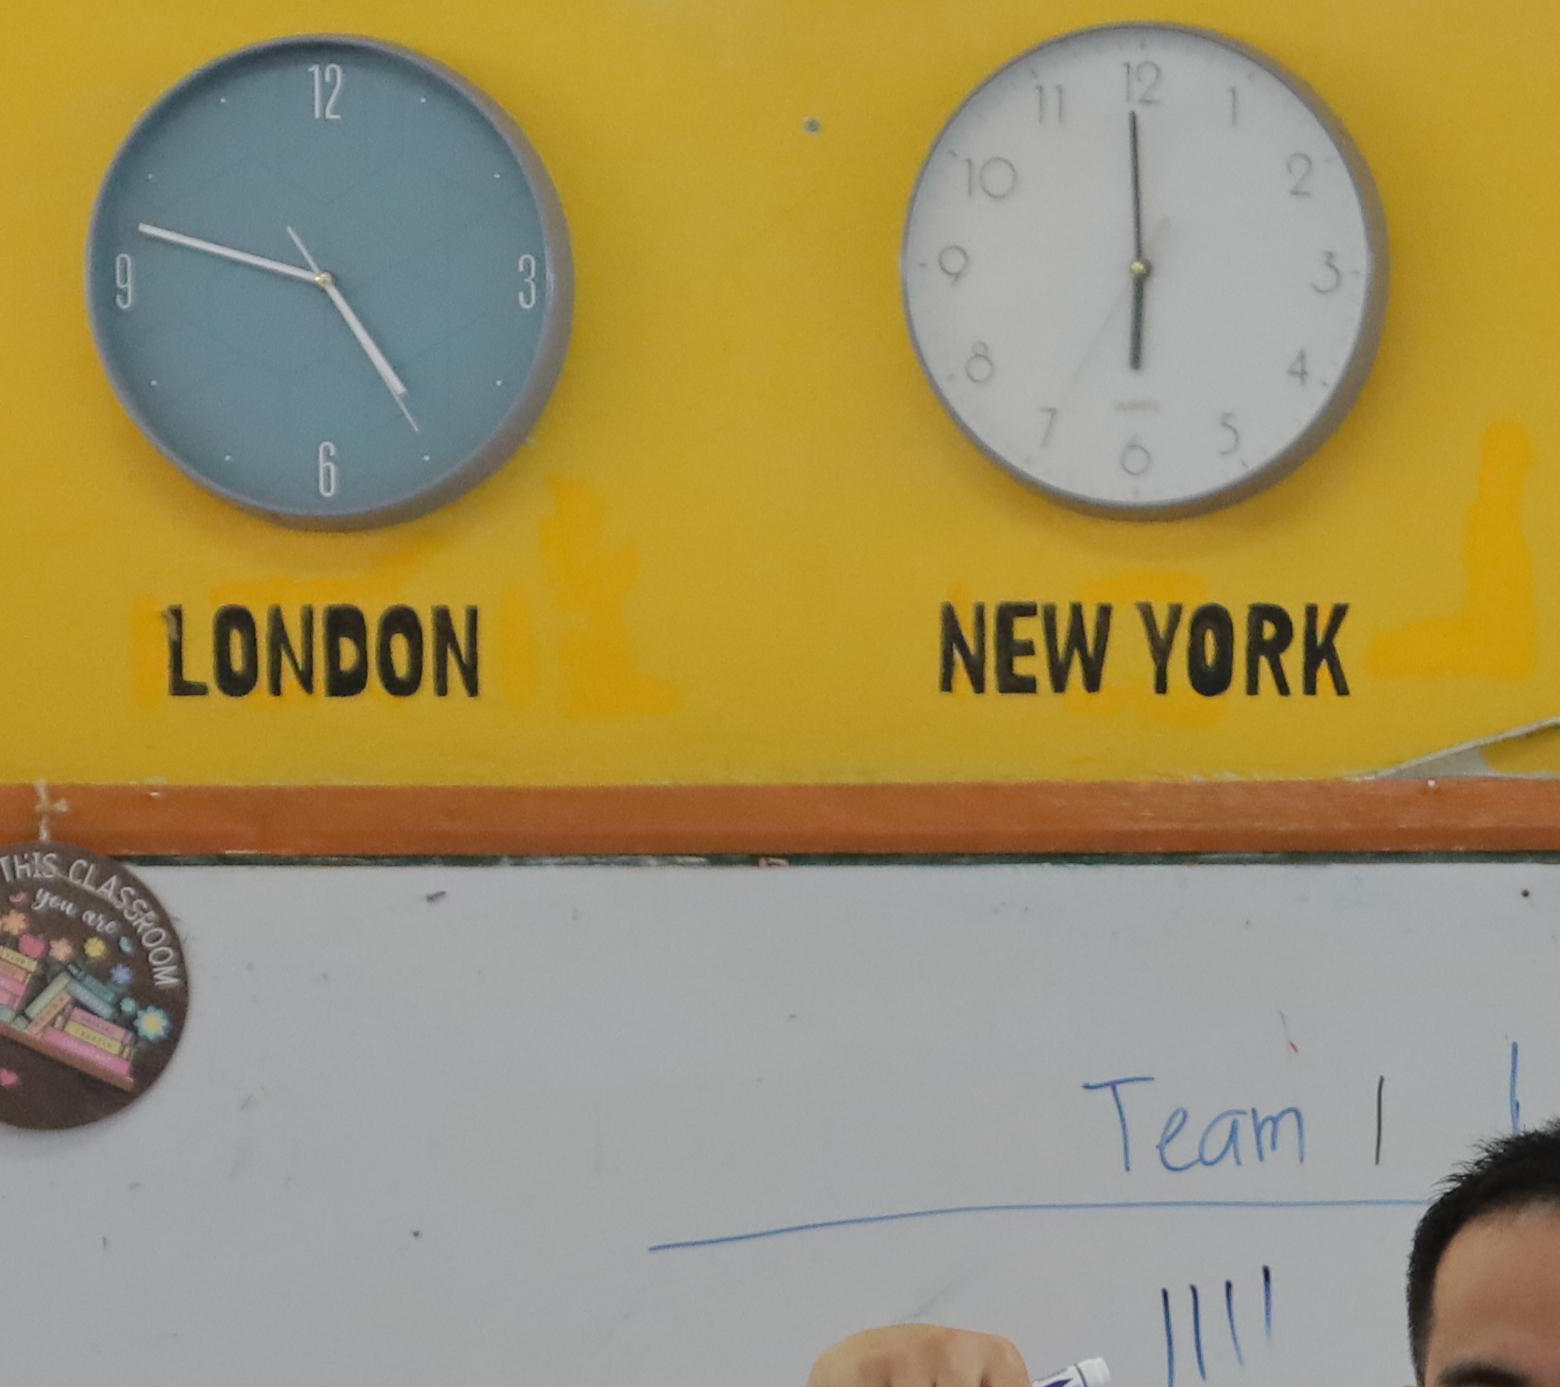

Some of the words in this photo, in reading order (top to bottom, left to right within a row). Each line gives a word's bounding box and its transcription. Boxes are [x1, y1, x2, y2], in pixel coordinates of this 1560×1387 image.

[309, 64, 342, 119] 12
[1036, 84, 1066, 124] 11
[1123, 61, 1161, 105] 12
[1228, 86, 1237, 126] 1
[963, 156, 1017, 200] 10
[1287, 152, 1311, 196] 2
[116, 254, 133, 308] 9
[519, 255, 536, 308] 3
[939, 245, 969, 284] 9
[1311, 251, 1340, 293] 3
[964, 341, 995, 383] 8
[1287, 348, 1309, 385] 4
[1040, 407, 1058, 448] 7
[1220, 412, 1240, 455] 5
[319, 442, 336, 497] 6
[1120, 437, 1151, 475] 6
[168, 605, 480, 697] LONDON
[939, 600, 1110, 694] NEW
[1137, 602, 1351, 698] YORK
[32, 888, 77, 917] you
[82, 909, 118, 934] are
[69, 859, 180, 988] CLASSROOM
[1083, 1075, 1307, 1173] Team
[1374, 1075, 1387, 1165] 1
